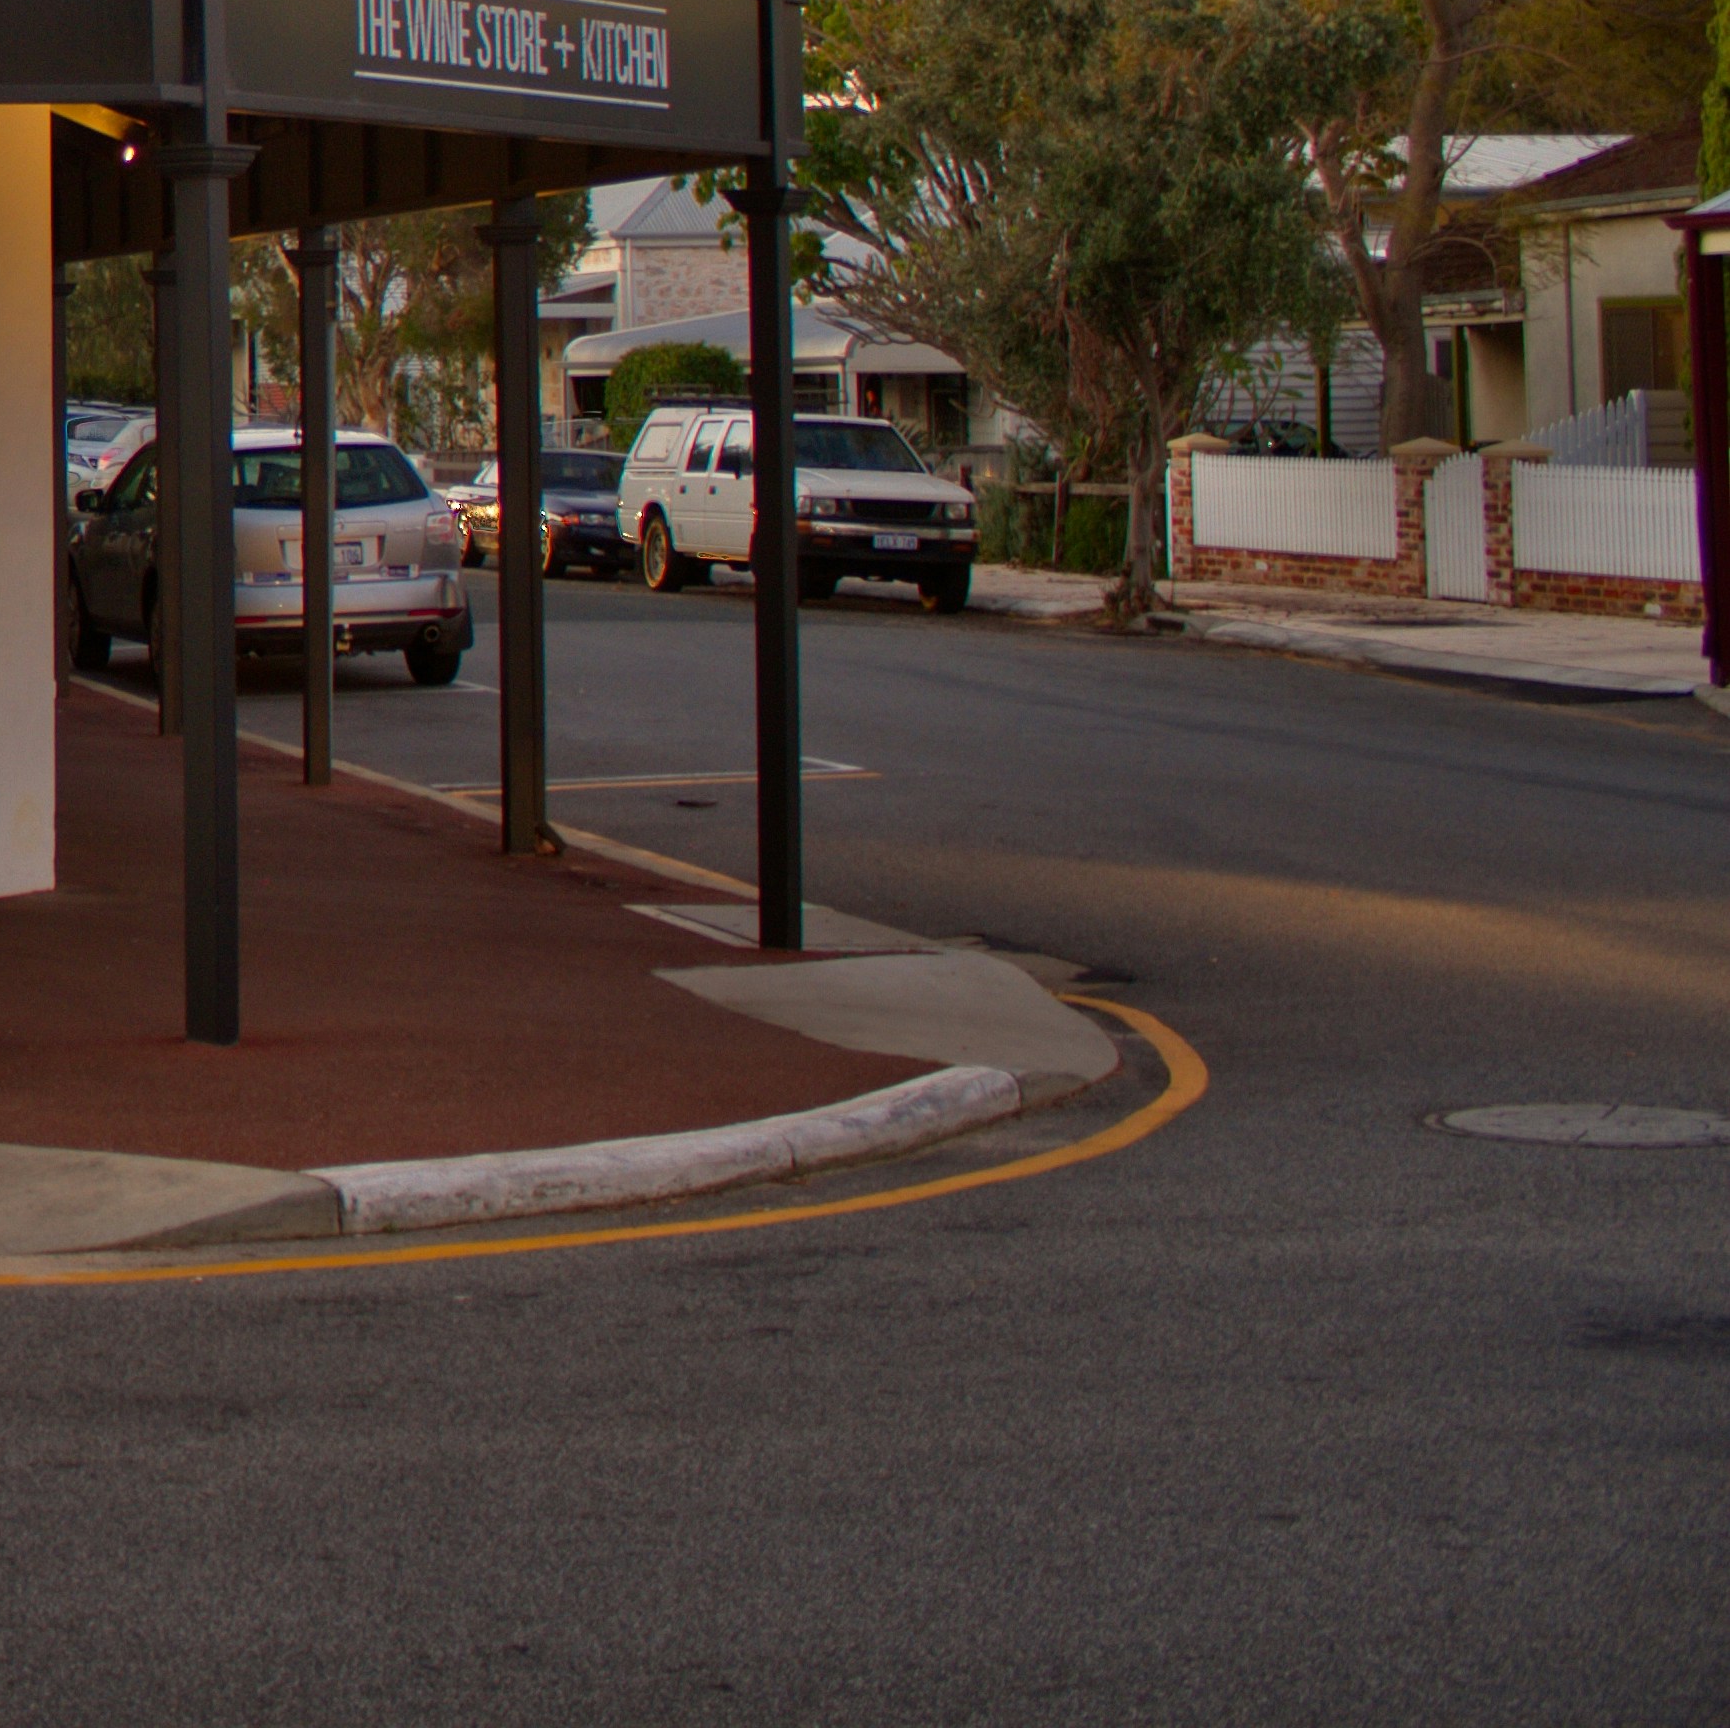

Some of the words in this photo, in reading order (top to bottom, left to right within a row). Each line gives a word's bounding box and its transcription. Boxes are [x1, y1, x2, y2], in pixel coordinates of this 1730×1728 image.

[475, 4, 548, 75] STORE
[554, 25, 575, 69] +
[581, 18, 667, 89] KITCHEN
